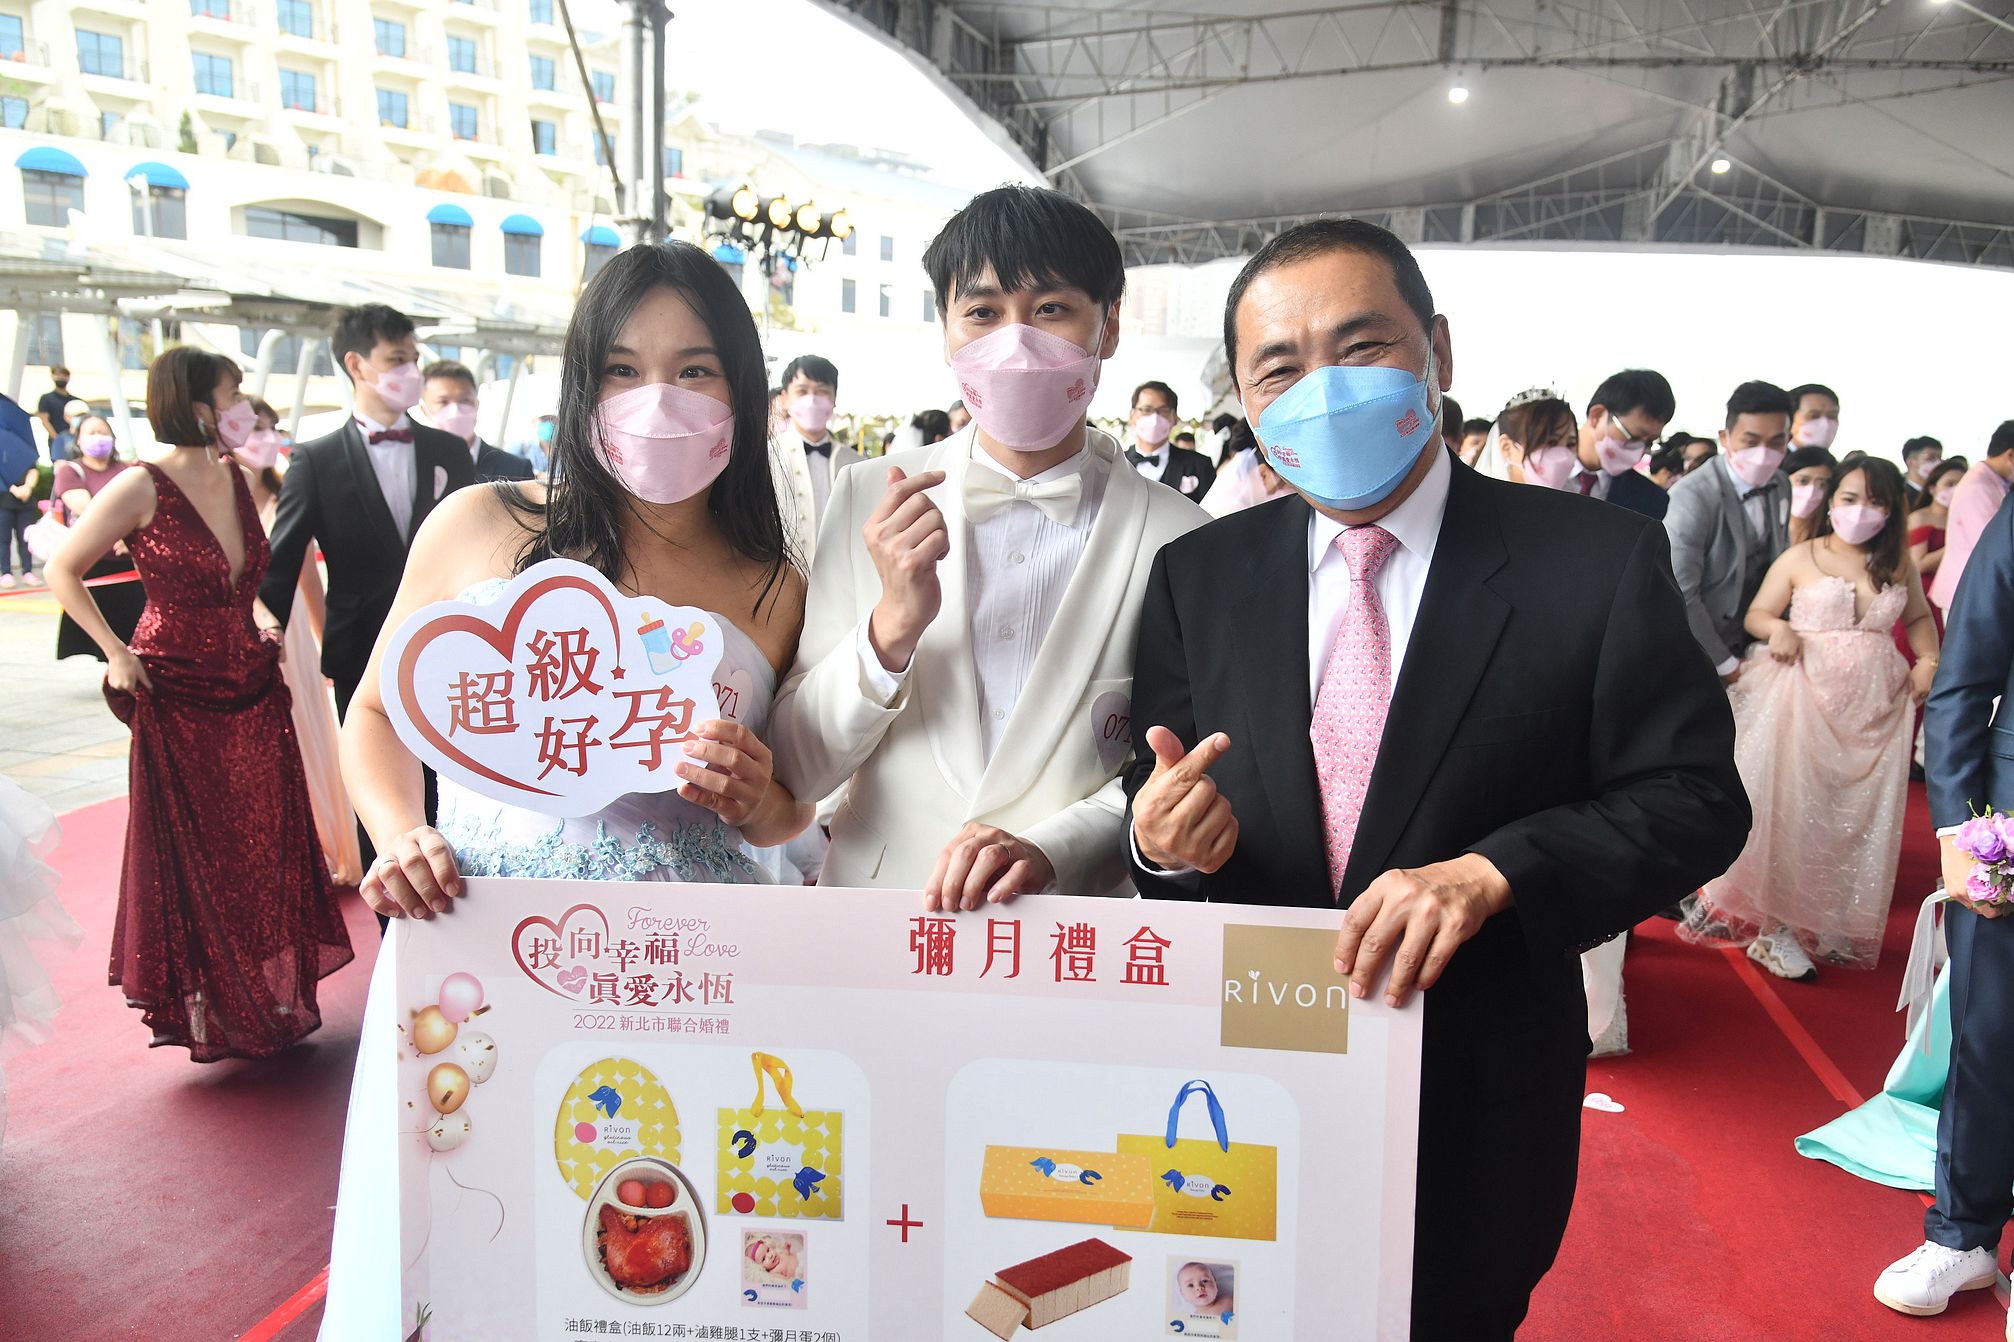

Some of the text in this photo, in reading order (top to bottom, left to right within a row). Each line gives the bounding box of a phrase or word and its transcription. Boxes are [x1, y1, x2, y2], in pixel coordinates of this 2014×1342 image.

[447, 627, 604, 738] 超級
[534, 684, 700, 781] 好孕
[1103, 713, 1131, 743] 07
[627, 906, 711, 931] Forever
[528, 927, 680, 973] 投向幸福
[683, 933, 741, 958] Love
[909, 916, 1172, 986] 彌月禮盒
[573, 1014, 730, 1035] 2022 新北市聯合婚禮
